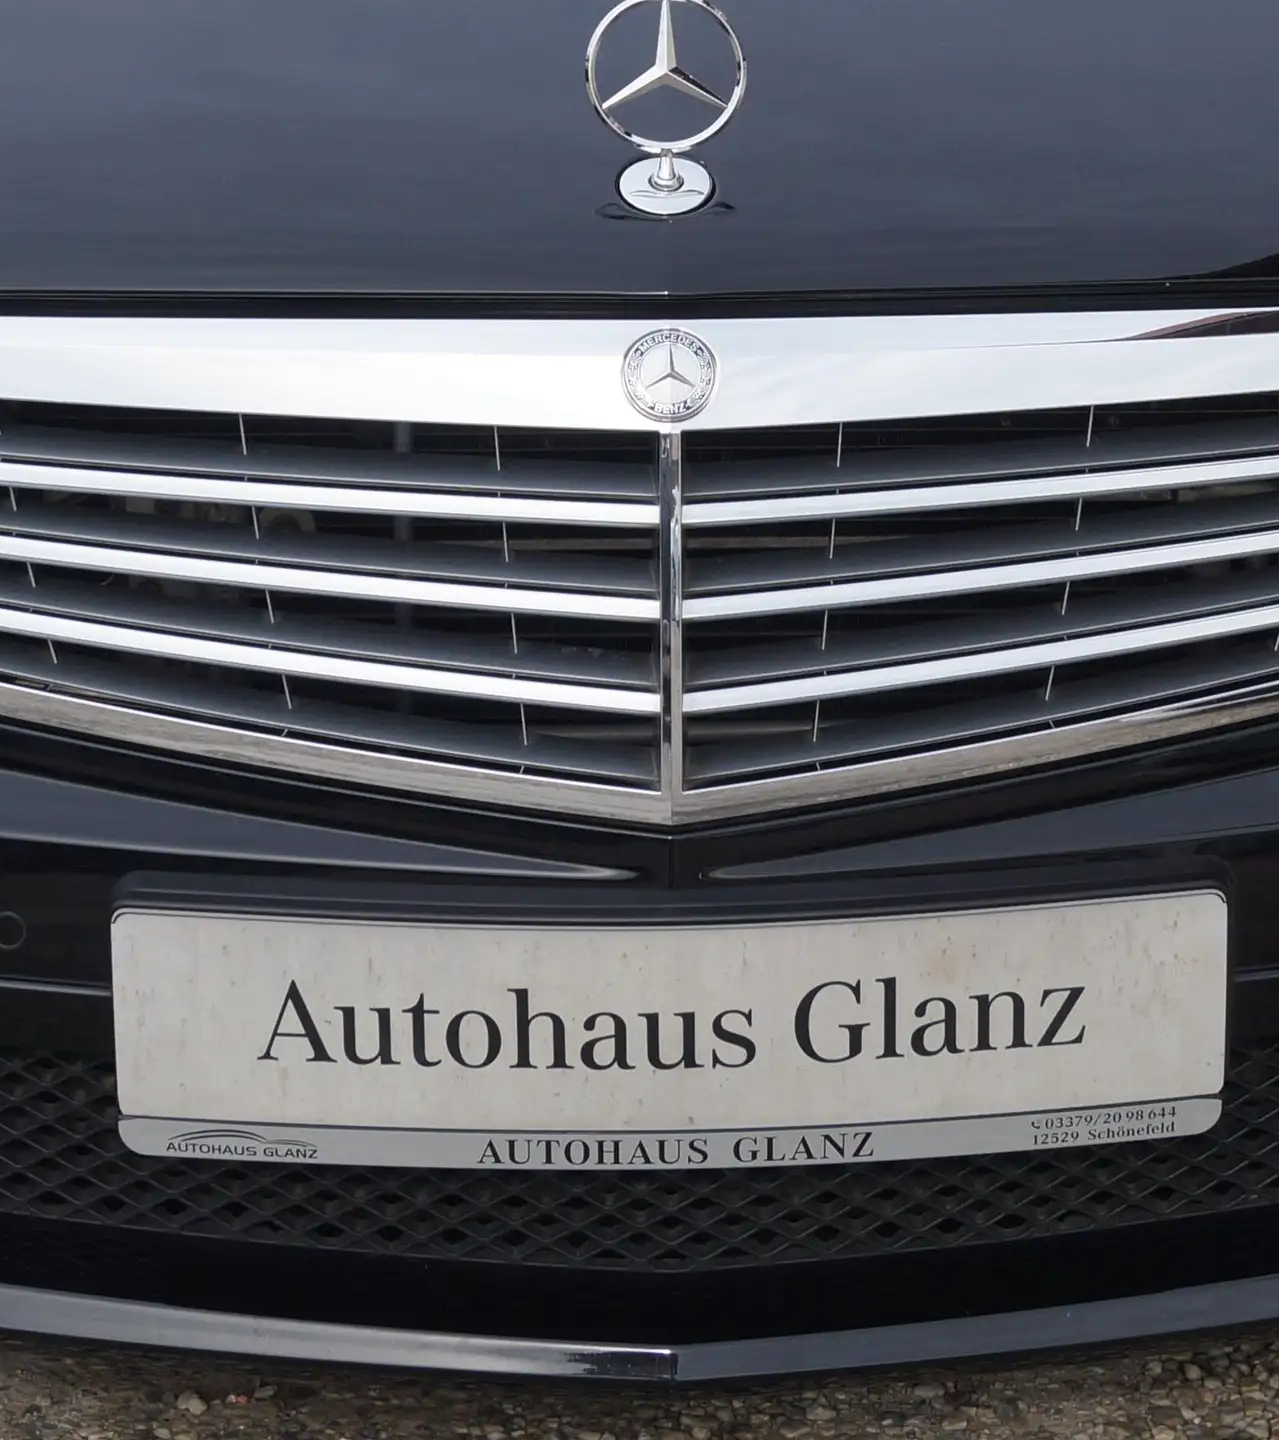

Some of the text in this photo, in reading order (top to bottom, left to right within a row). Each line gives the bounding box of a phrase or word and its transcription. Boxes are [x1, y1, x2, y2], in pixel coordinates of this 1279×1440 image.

[638, 333, 700, 354] MERCEDES
[653, 402, 688, 415] BENZ
[257, 976, 1087, 1071] Autohaus Glanz
[1033, 1121, 1176, 1146] 12529 Schönefeld
[166, 1141, 319, 1160] AUTOHAUS GLANZ
[476, 1131, 875, 1166] AUTOHAUS GLANZ
